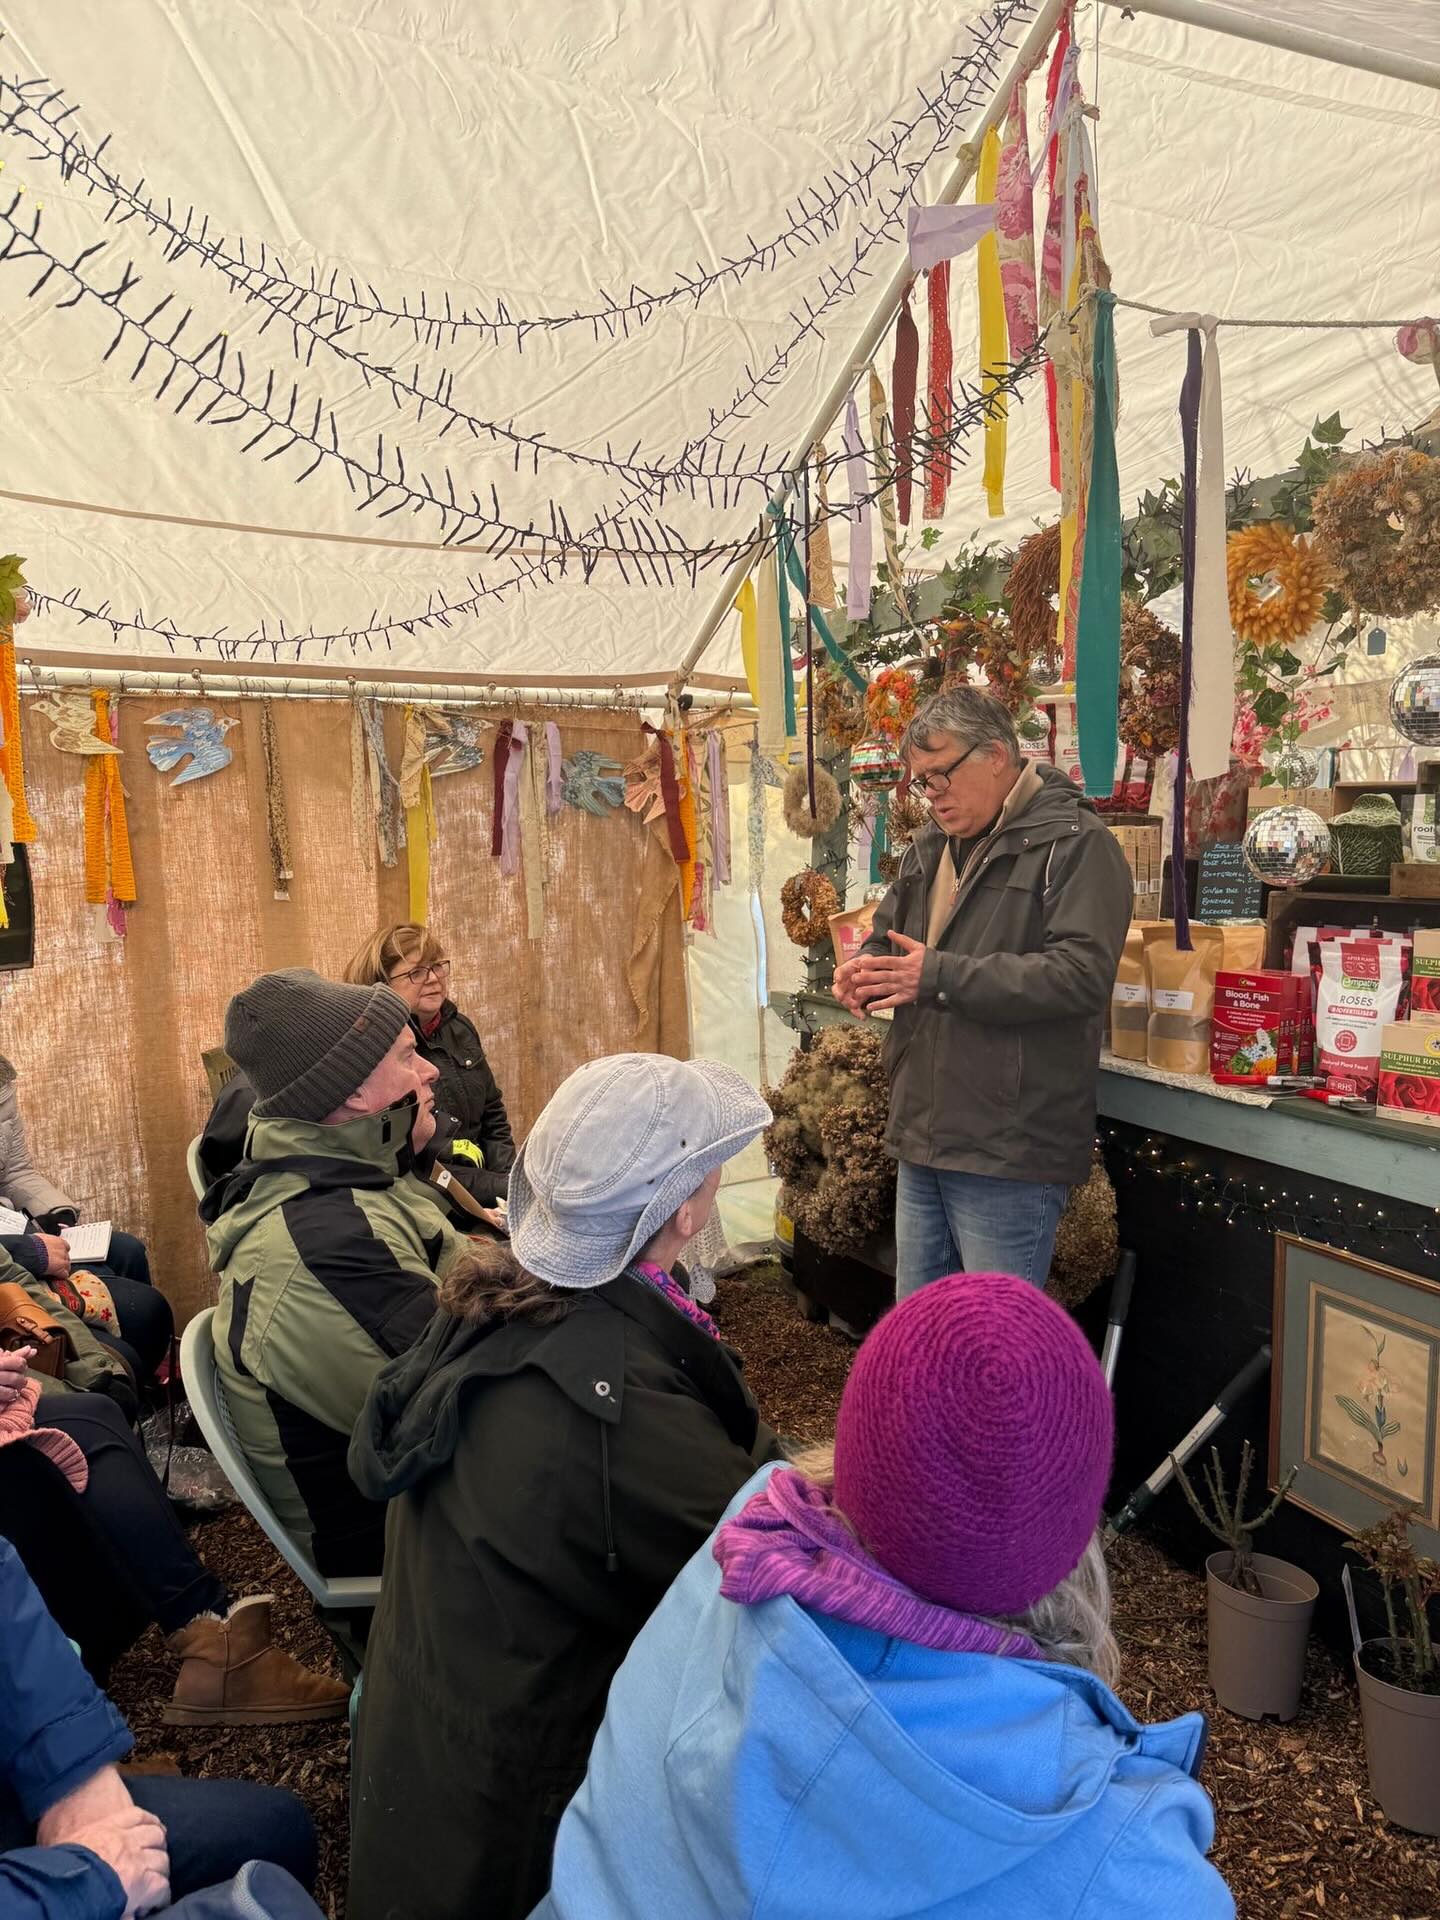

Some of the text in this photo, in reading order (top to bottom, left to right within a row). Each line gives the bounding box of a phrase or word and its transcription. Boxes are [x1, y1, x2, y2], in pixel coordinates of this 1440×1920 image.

[1415, 958, 1440, 966] SULPH
[1343, 977, 1379, 988] empathy
[1225, 989, 1270, 1002] Blood, Fish
[1339, 994, 1374, 1007] ROSES
[1239, 1000, 1261, 1009] Bone
[1321, 1058, 1340, 1066] Natural
[1383, 1052, 1421, 1064] SULPHUR
[1422, 1057, 1440, 1066] ROS
[1337, 1083, 1353, 1092] RHS
